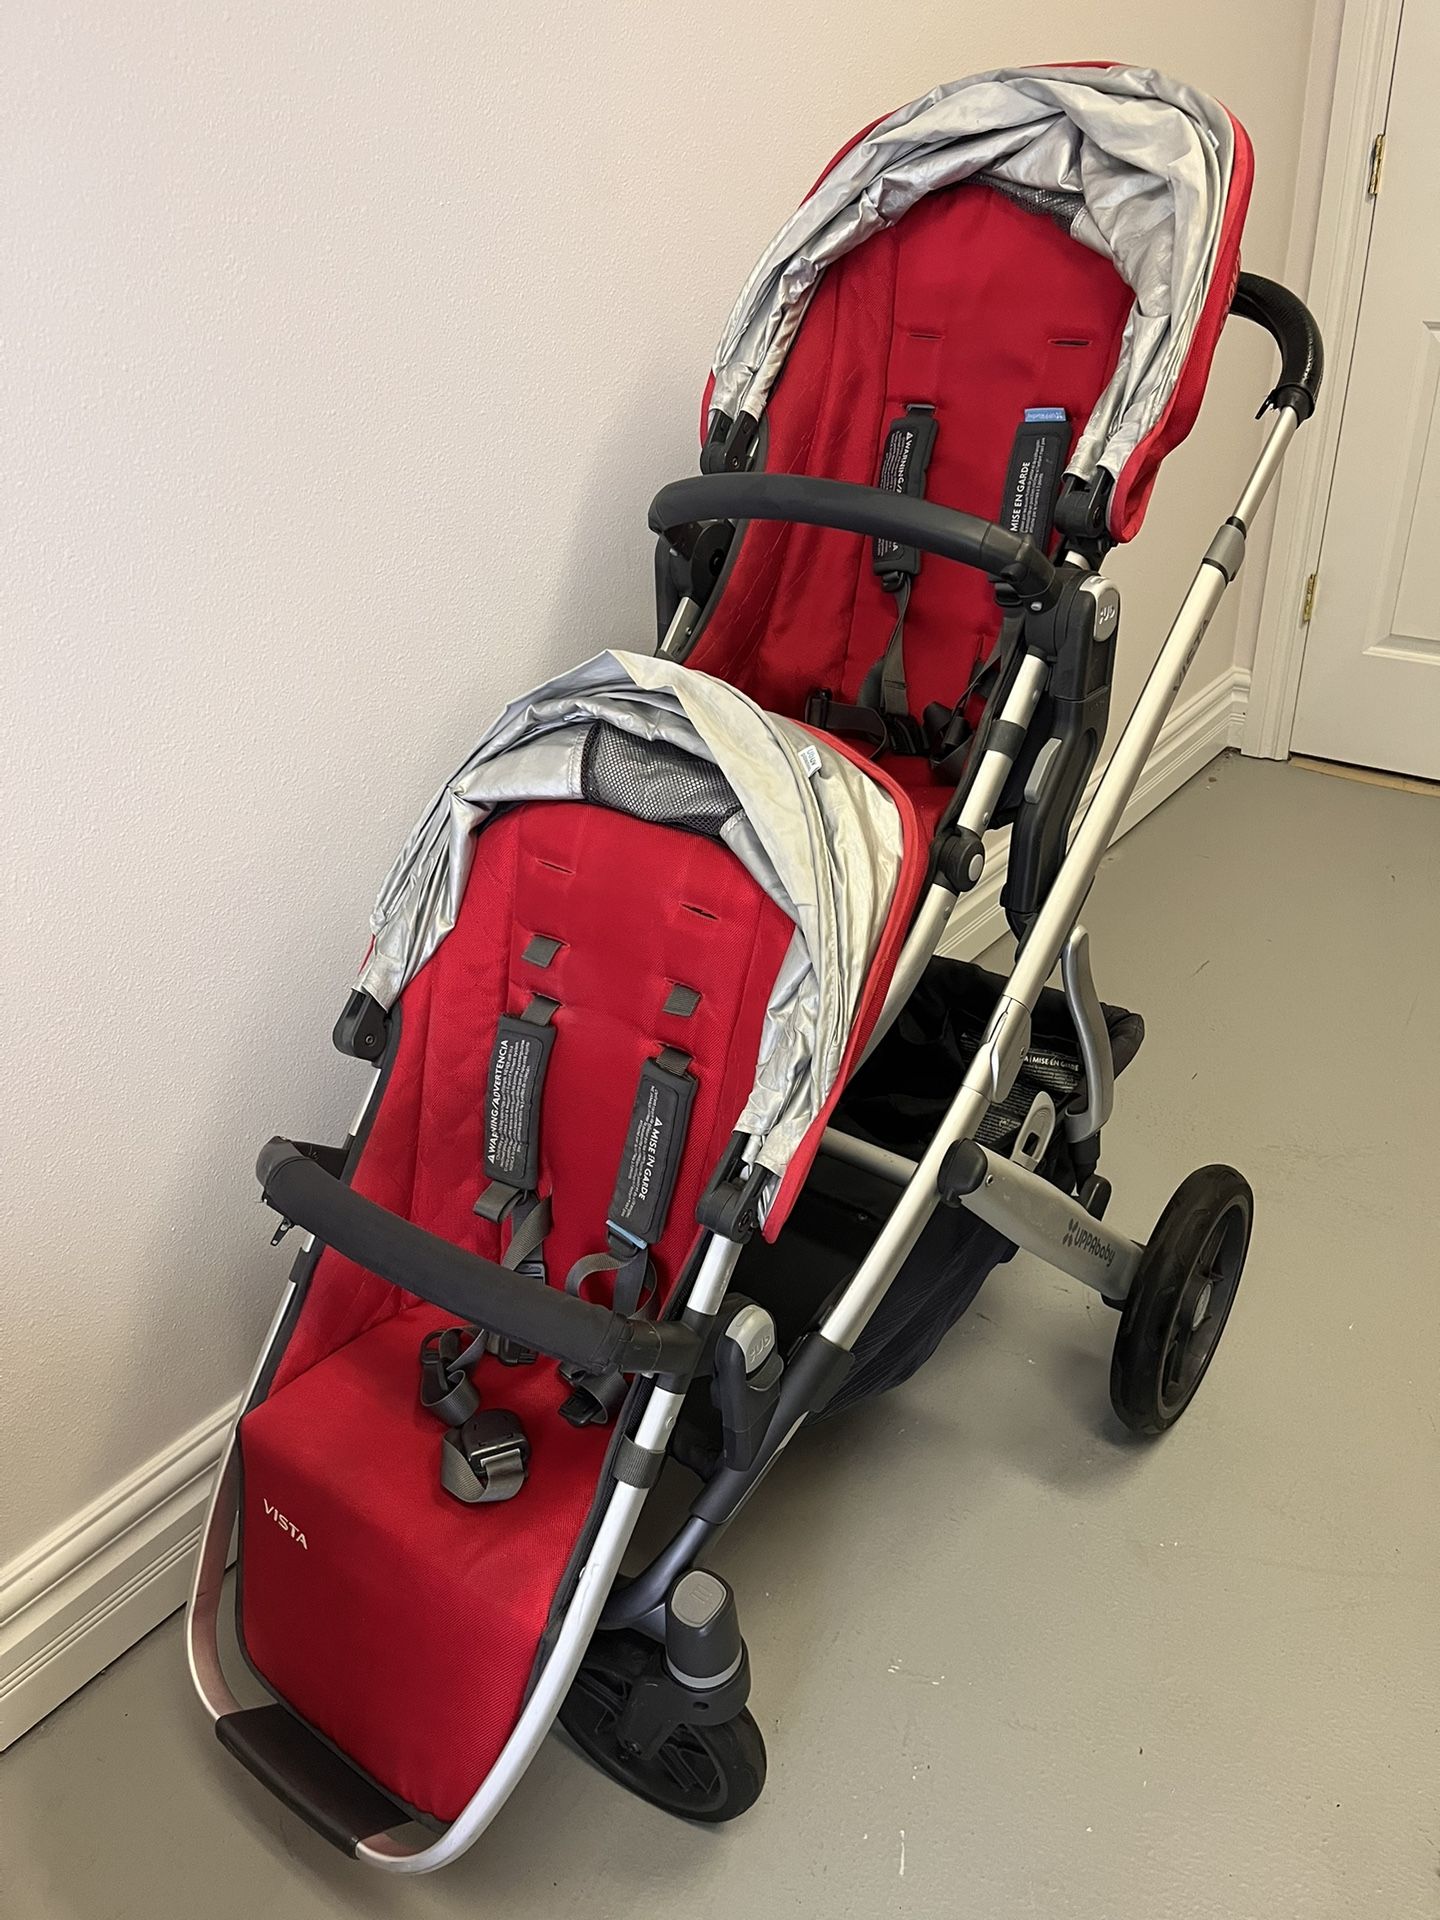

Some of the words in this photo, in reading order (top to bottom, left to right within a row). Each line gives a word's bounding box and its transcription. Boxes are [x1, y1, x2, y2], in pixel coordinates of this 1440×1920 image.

[1016, 461, 1031, 492] GARDE
[1013, 494, 1023, 507] EN
[1010, 509, 1021, 532] MISE
[647, 1127, 661, 1154] MISE
[637, 1168, 652, 1200] GARDE
[1074, 1229, 1116, 1267] UPPAbaby
[263, 1498, 309, 1552] VISTA
